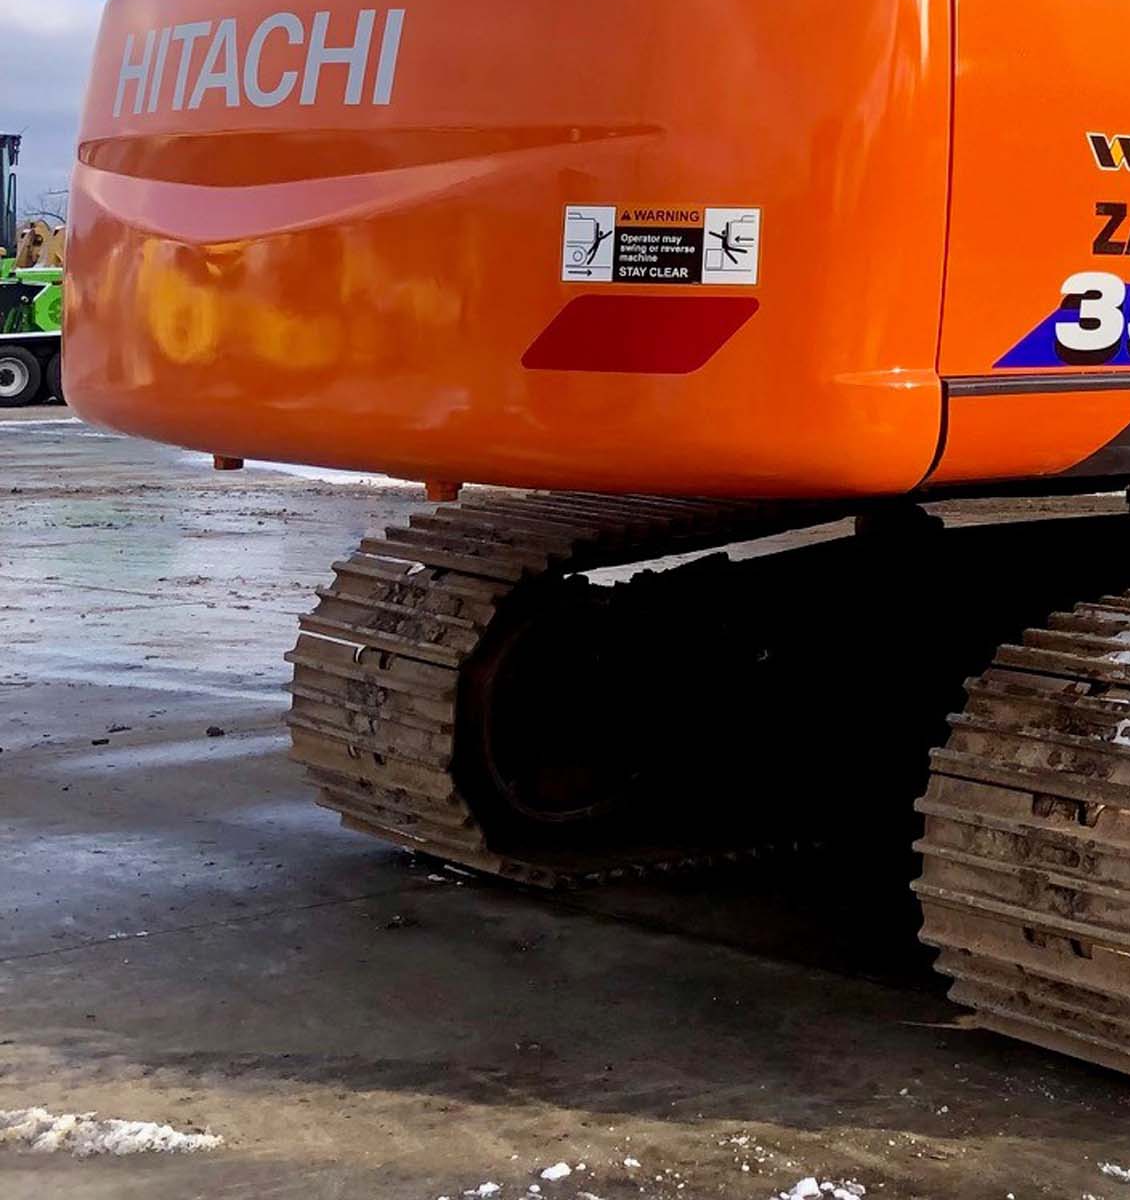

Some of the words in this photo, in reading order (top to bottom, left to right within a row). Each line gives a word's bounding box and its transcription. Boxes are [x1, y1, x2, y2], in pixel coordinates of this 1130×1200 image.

[112, 8, 405, 118] HITACHI
[634, 210, 700, 222] WARNING
[620, 233, 661, 244] Operator
[662, 235, 682, 245] may
[620, 244, 648, 254] swing
[660, 246, 695, 254] reverse
[619, 253, 658, 263] machine
[618, 267, 647, 277] STAY
[649, 267, 689, 278] CLEAR
